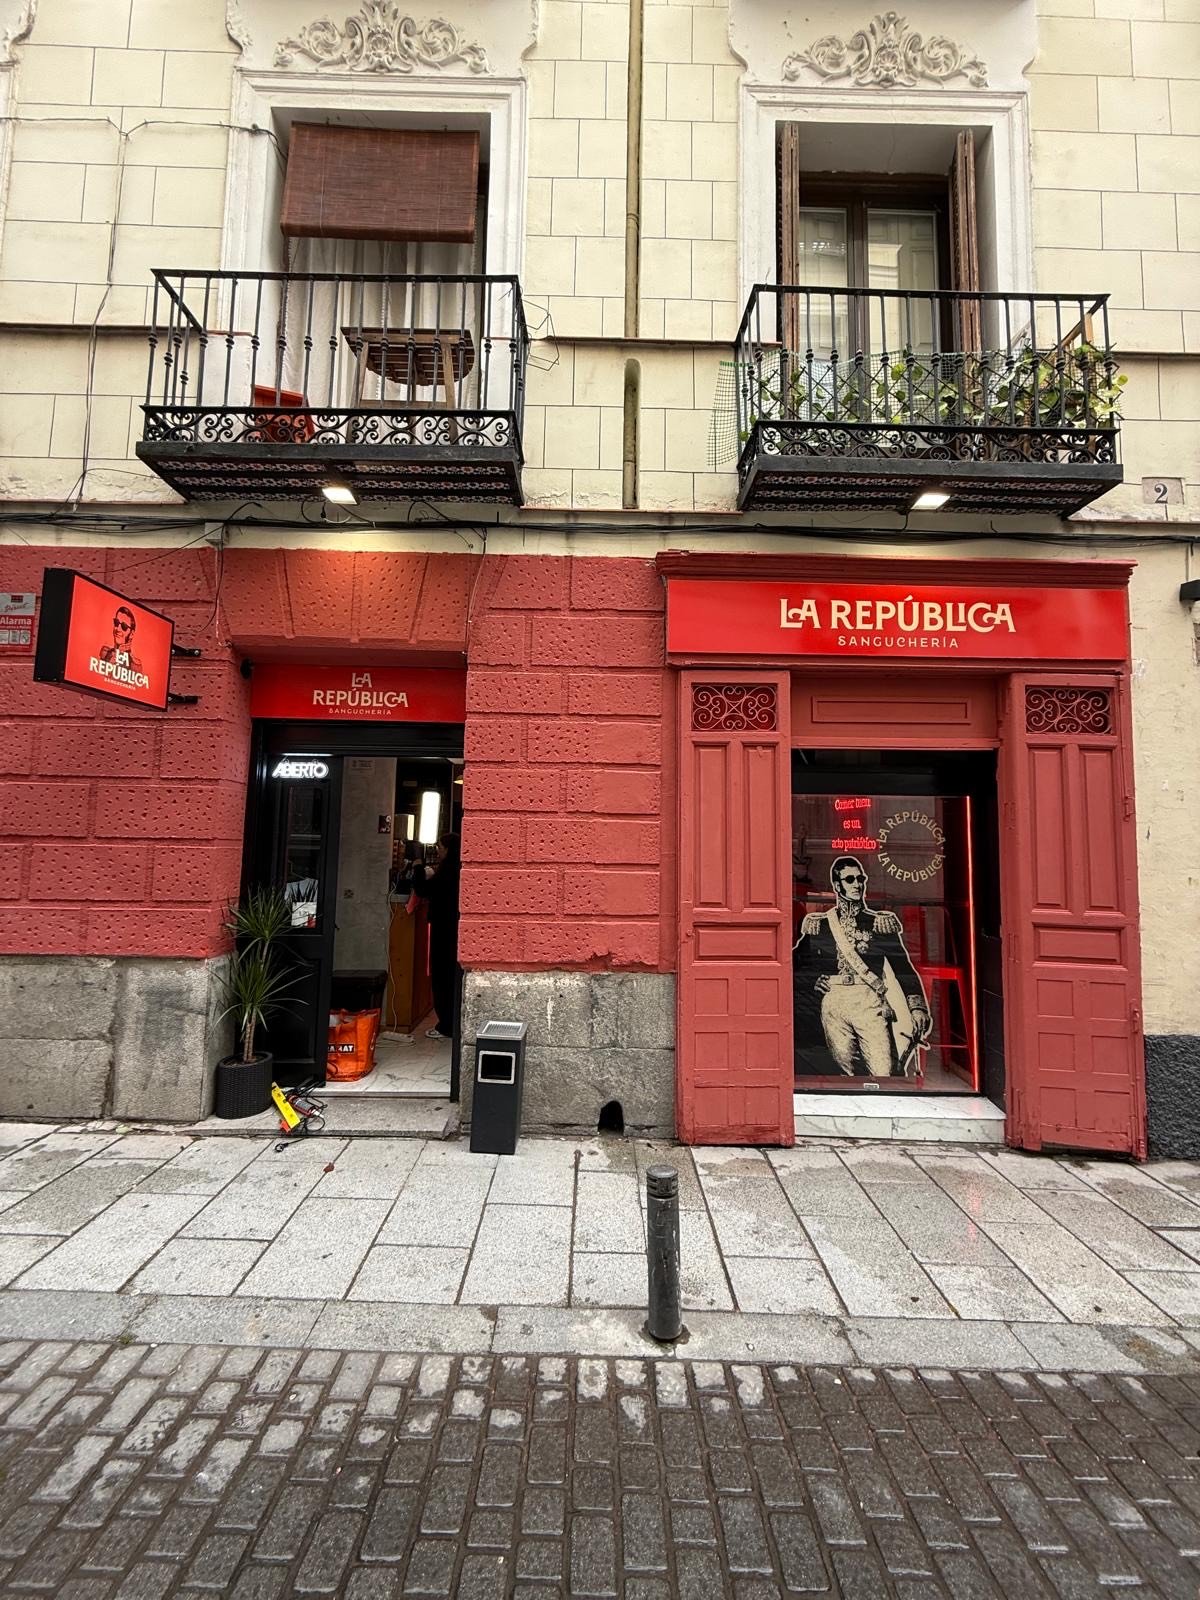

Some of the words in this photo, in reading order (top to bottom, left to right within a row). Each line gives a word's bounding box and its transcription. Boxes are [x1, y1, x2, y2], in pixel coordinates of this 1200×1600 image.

[1154, 482, 1168, 504] 2
[0, 617, 32, 625] Alarma
[780, 598, 821, 629] LA
[830, 595, 1016, 633] REPÚBLICA
[837, 635, 959, 648] SANGUCHERÍA
[115, 648, 130, 666] LA
[89, 656, 149, 689] REPÚBLICA
[351, 672, 372, 688] LA
[312, 688, 408, 708] REPÚBLICA
[834, 799, 854, 810] Comer
[843, 820, 850, 829] es
[851, 819, 861, 829] un
[876, 828, 890, 843] LA
[885, 809, 947, 846] REPÚBLICA
[831, 838, 843, 848] acto
[877, 852, 891, 867] LA
[887, 853, 947, 883] REPÚBLICA
